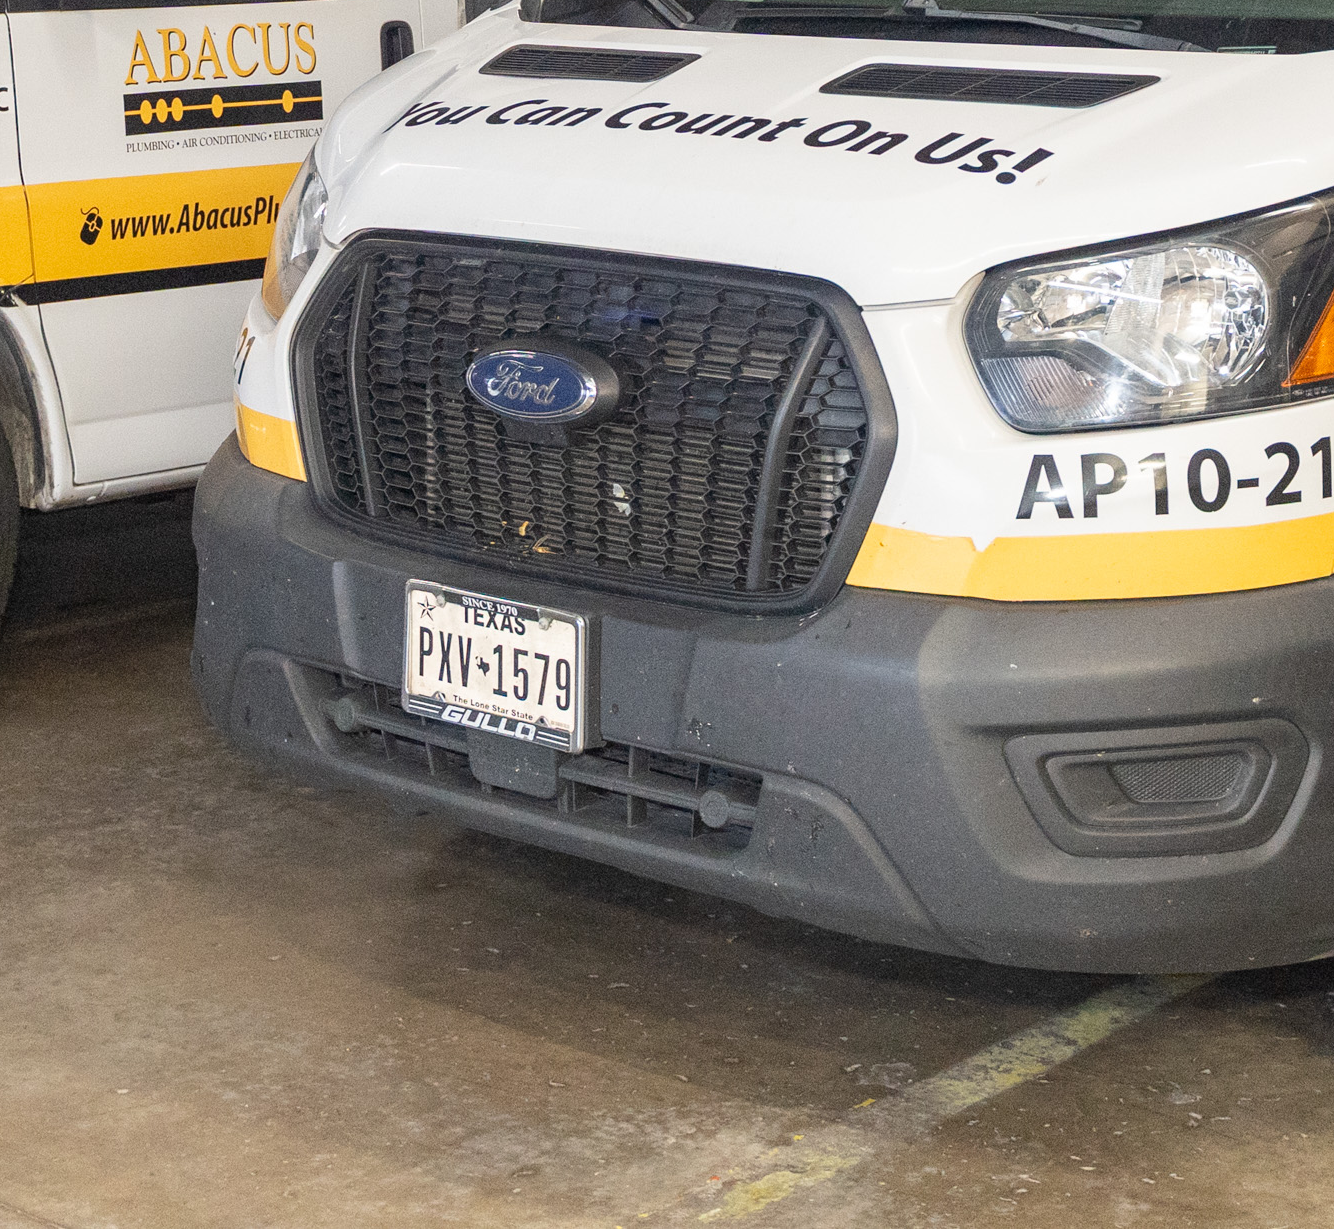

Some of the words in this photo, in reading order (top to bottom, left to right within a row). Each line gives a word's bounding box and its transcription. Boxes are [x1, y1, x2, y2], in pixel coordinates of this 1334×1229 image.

[124, 22, 318, 86] ABACUS
[126, 139, 175, 153] PLUMBING
[181, 137, 198, 149] AIR
[199, 132, 267, 148] CONDITIONING
[274, 127, 323, 141] ELECTRICA
[382, 101, 490, 134] You
[485, 99, 603, 127] Can
[604, 102, 809, 142] Count
[803, 120, 909, 155] On
[914, 132, 1055, 185] Us!
[487, 360, 560, 405] Ford
[1017, 436, 1334, 520] AP10-21
[462, 596, 495, 611] SINCE
[496, 602, 518, 616] 1970
[463, 607, 526, 636] TEXAS
[453, 695, 468, 705] The
[470, 699, 490, 710] Lone
[492, 704, 509, 715] Star
[511, 709, 533, 721] State
